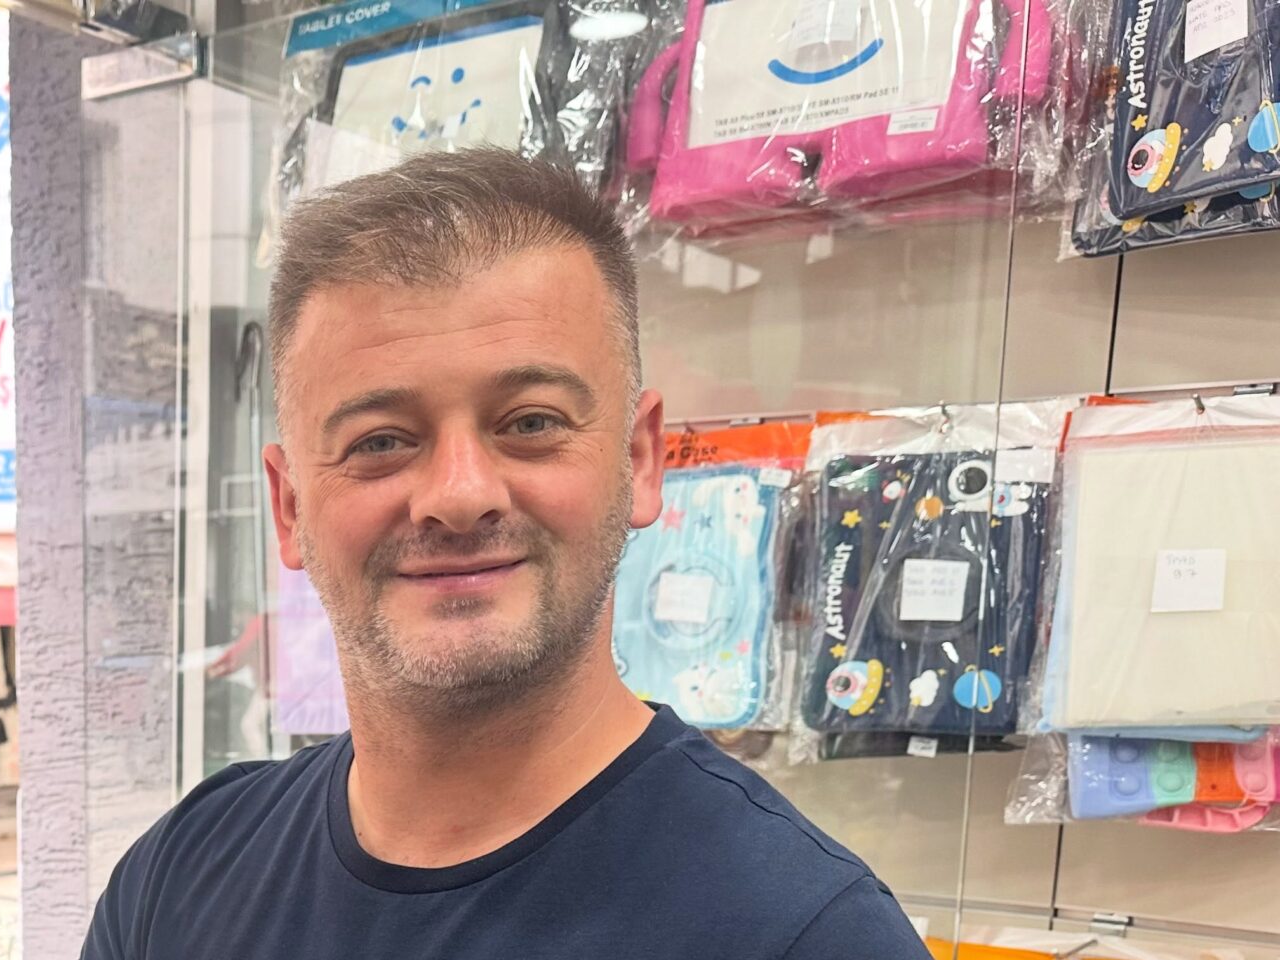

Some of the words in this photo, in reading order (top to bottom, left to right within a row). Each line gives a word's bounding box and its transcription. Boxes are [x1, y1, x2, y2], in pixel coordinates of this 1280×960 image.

[298, 13, 342, 36] TABLET
[345, 1, 392, 24] COVER
[823, 541, 854, 641] Astronaut
